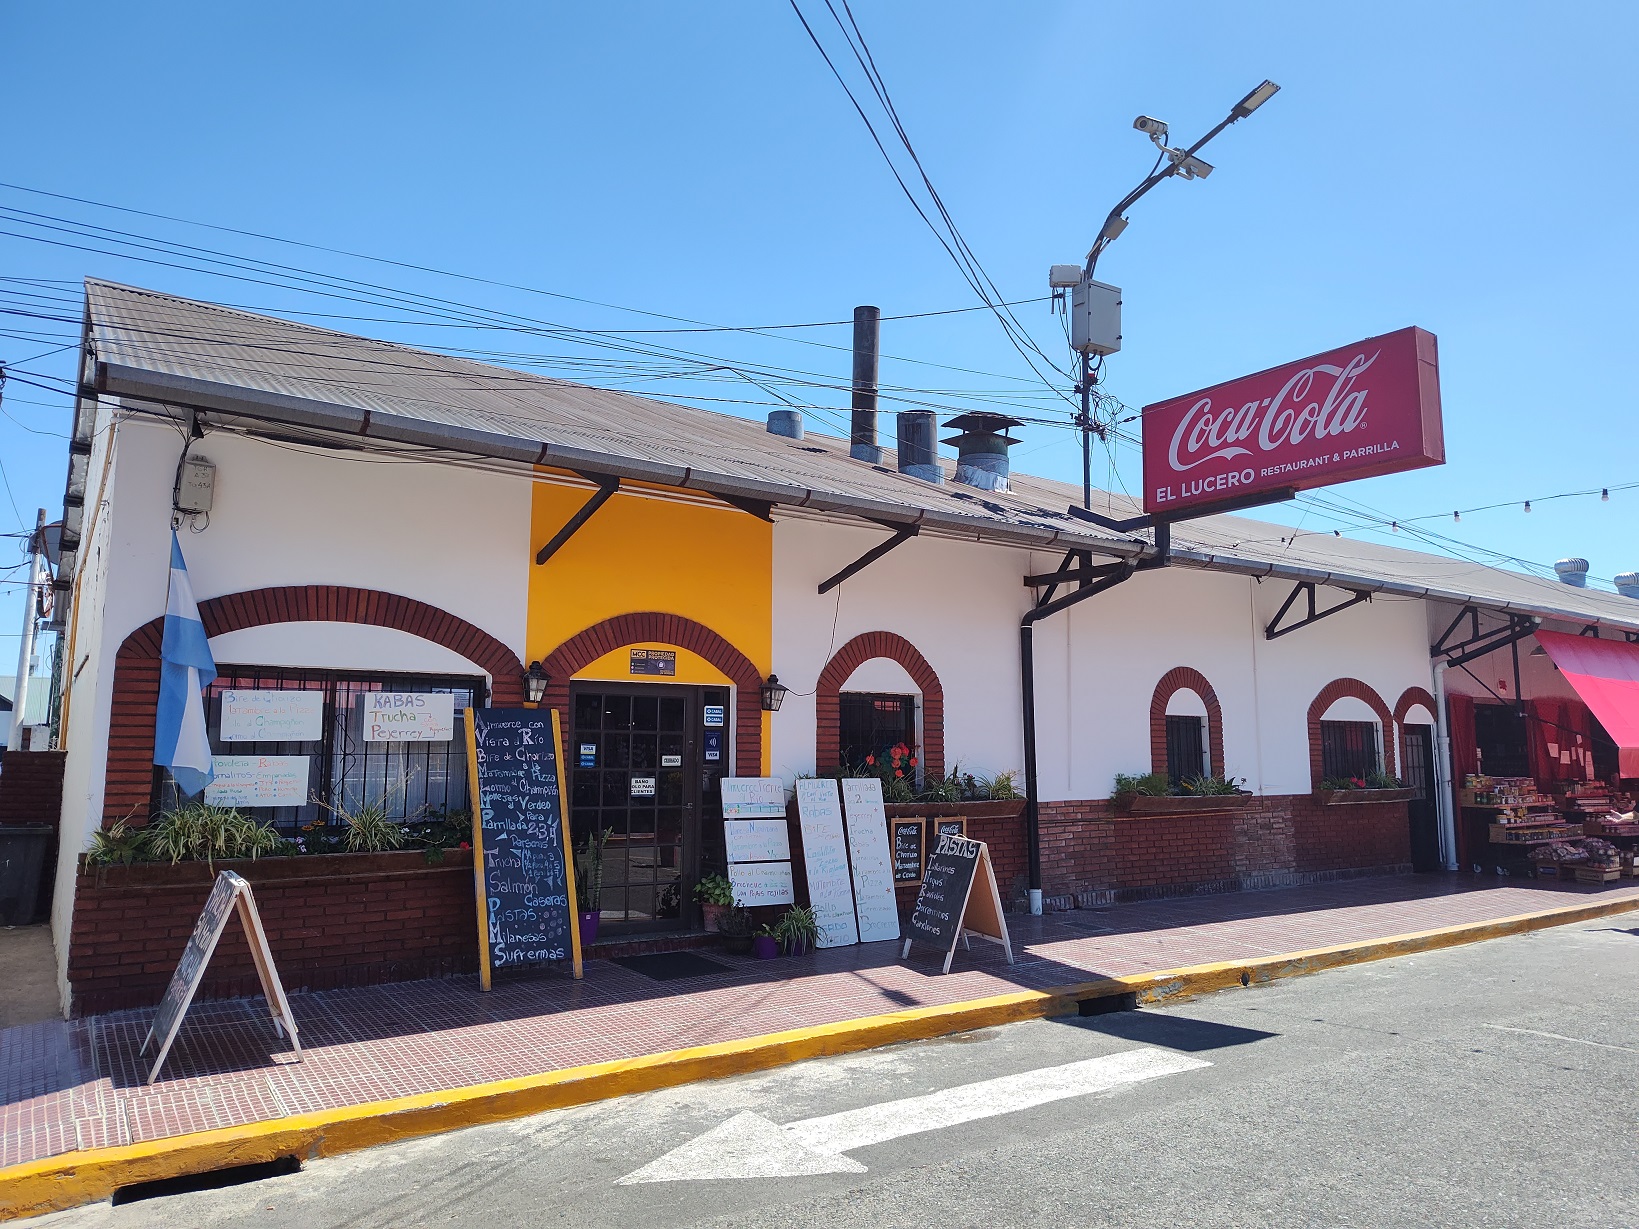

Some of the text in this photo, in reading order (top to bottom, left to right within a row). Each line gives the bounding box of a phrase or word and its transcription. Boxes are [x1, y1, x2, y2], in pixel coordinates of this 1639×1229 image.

[1168, 348, 1381, 472] Coca-Cola
[1156, 440, 1400, 502] EL LUCERO RESTAURANT & PARRILLA
[369, 710, 416, 722] Trucha
[372, 724, 422, 740] Pejerrey
[516, 746, 554, 761] Chorizo
[519, 796, 551, 810] Verdeo
[482, 809, 528, 830] Parrillada
[526, 811, 544, 820] Para
[935, 835, 976, 858] PASTAS
[488, 894, 567, 923] Pastas Caseras
[489, 920, 546, 943] Milanesas
[494, 942, 564, 967] Supremas
